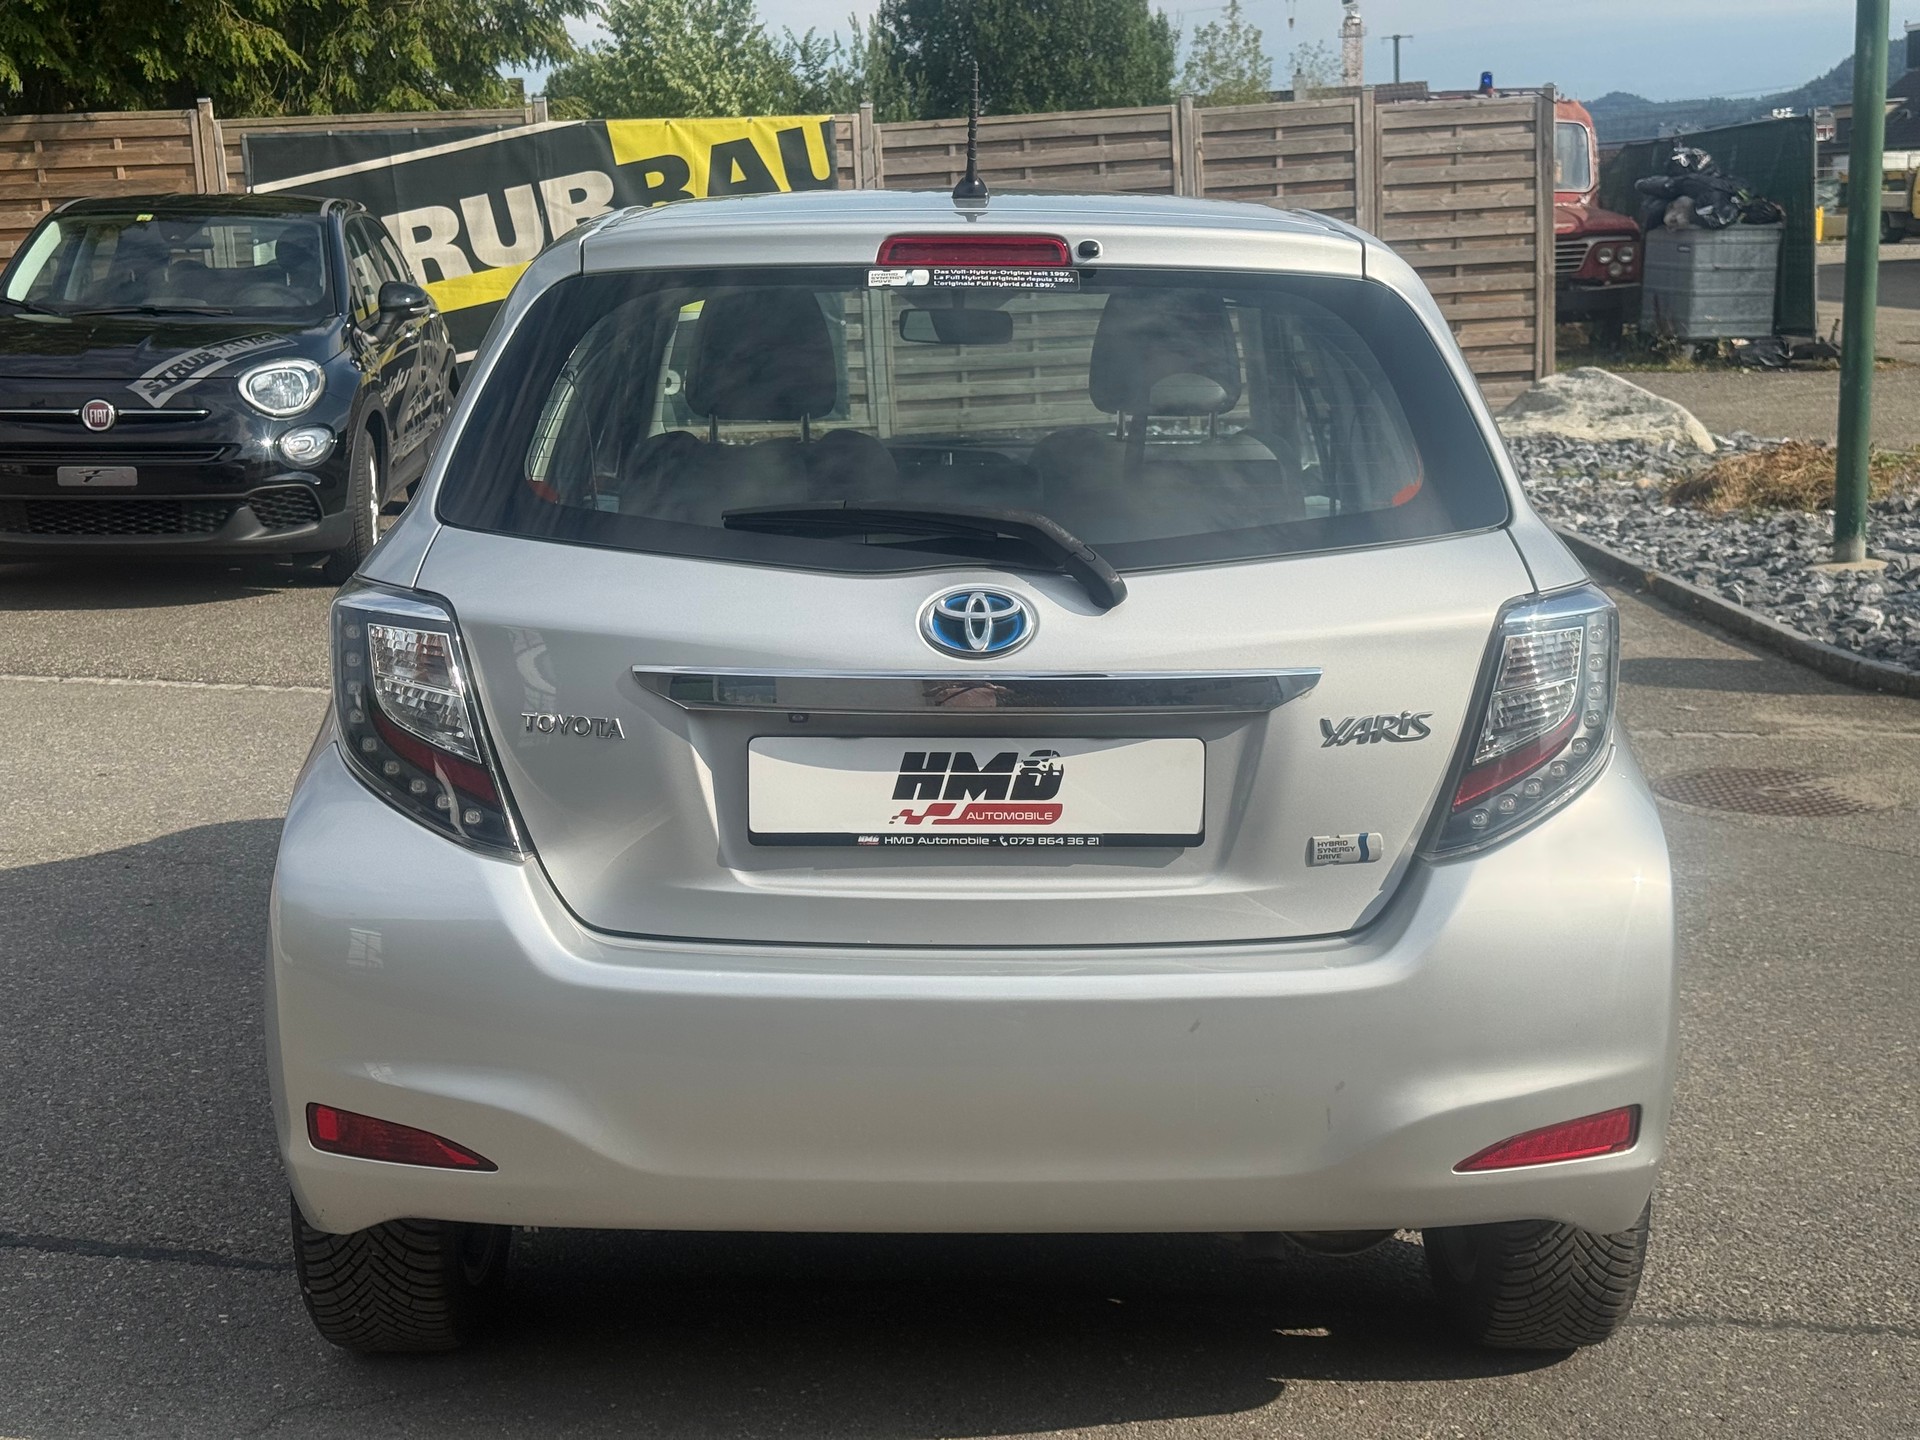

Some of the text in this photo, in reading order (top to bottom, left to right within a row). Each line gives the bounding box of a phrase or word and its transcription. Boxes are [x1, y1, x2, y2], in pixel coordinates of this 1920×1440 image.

[143, 351, 216, 393] STRUB
[90, 408, 108, 424] FIAT
[521, 711, 625, 740] TOYOTA
[892, 750, 1064, 801] HMD
[966, 811, 1053, 821] AUTOMOBILE
[884, 836, 914, 845] HMD
[917, 835, 990, 845] Automobile
[1009, 836, 1035, 845] 079
[1038, 836, 1064, 845] 864
[1067, 836, 1084, 845] 36
[1087, 836, 1099, 845] 21
[1317, 840, 1348, 848] HYBRID
[1317, 846, 1356, 854] SYNERGY
